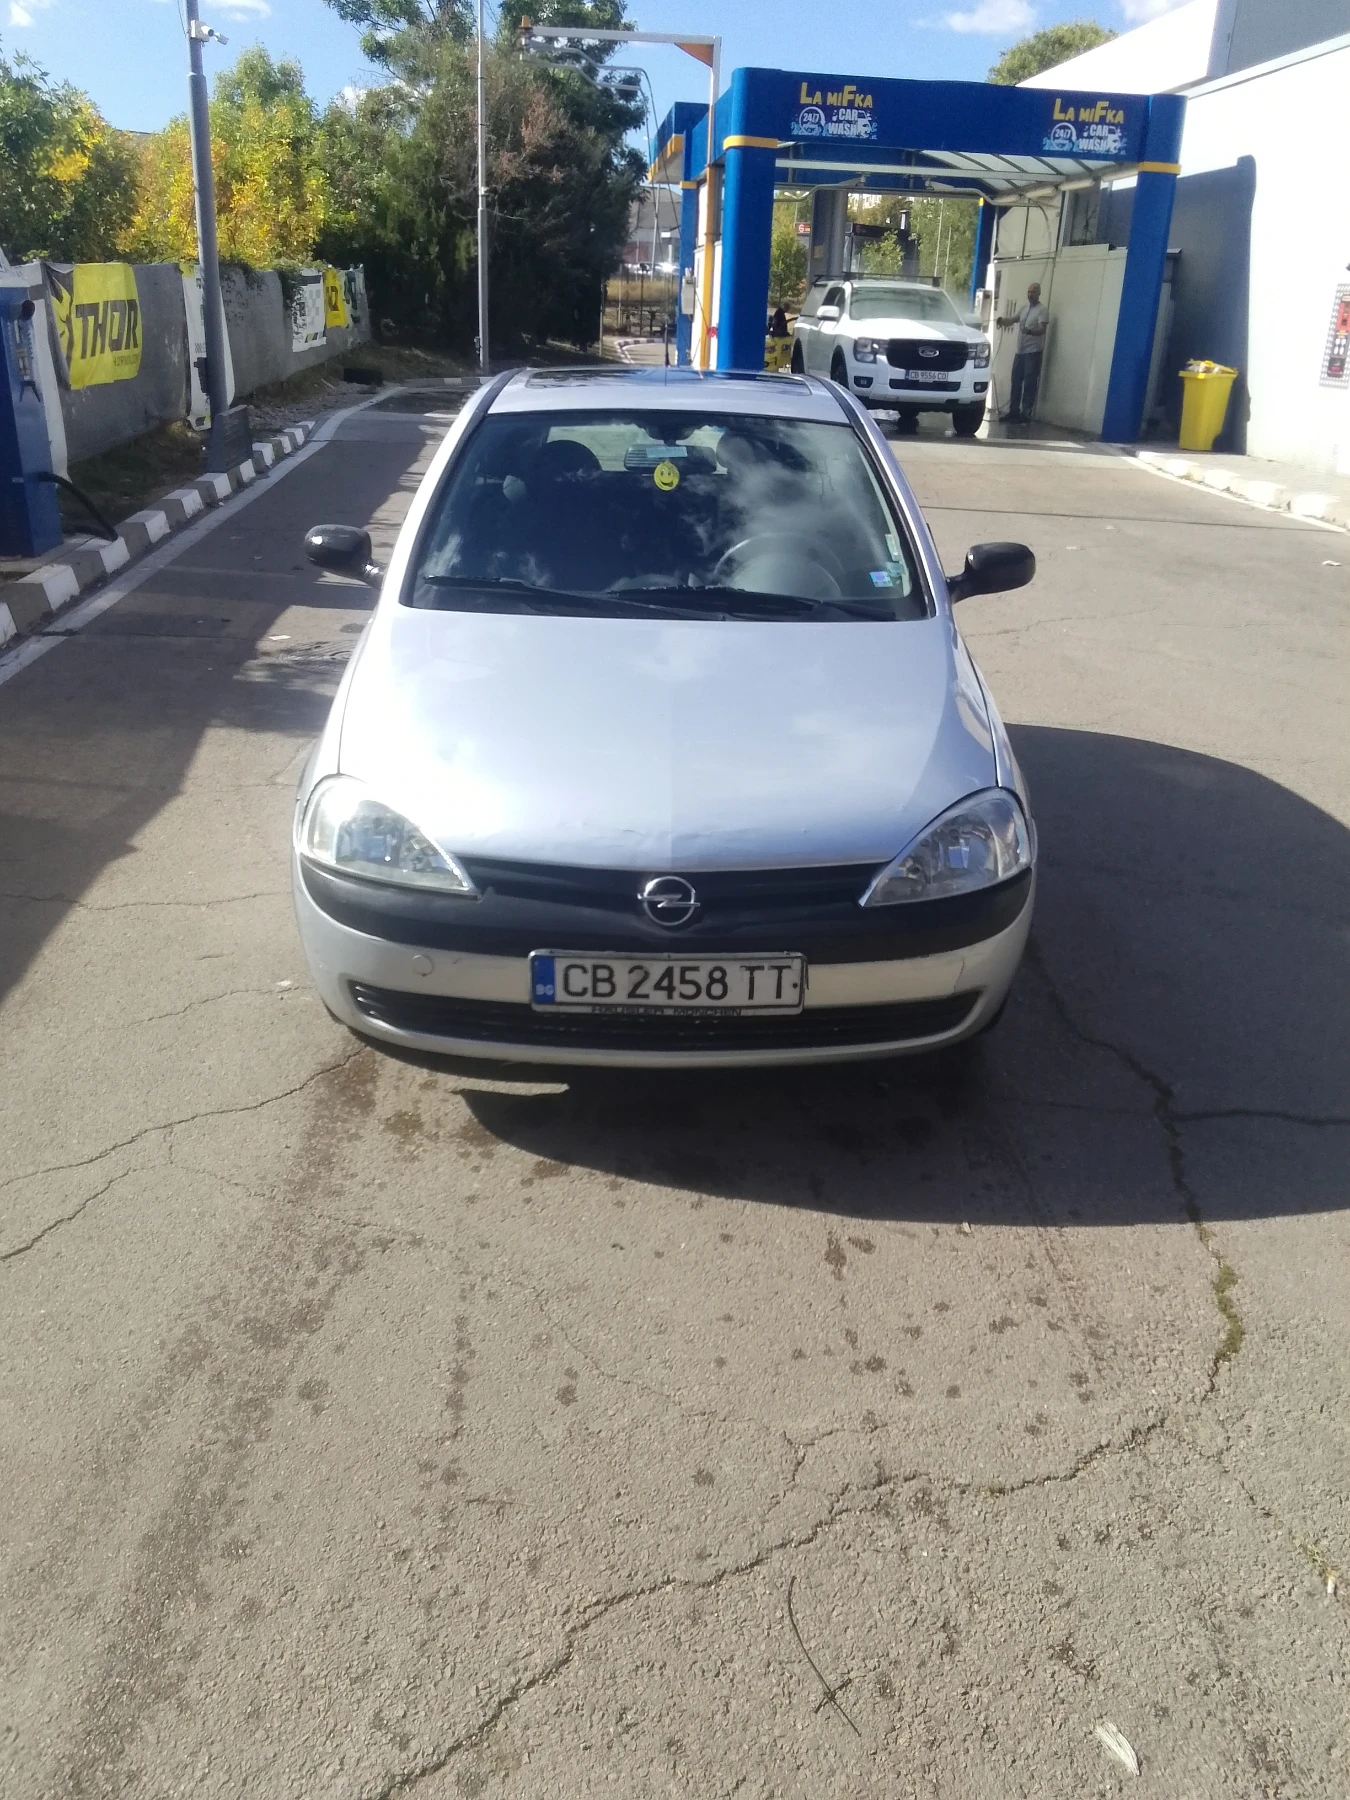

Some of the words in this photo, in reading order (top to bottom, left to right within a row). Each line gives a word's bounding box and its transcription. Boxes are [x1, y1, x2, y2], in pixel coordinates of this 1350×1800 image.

[838, 108, 858, 121] CAR
[829, 122, 858, 135] WASH
[1089, 124, 1109, 137] CAR
[1079, 138, 1108, 150] WASH
[75, 299, 139, 360] THOR
[563, 964, 617, 998] CB
[627, 965, 729, 1001] 2458
[740, 965, 793, 1001] TT
